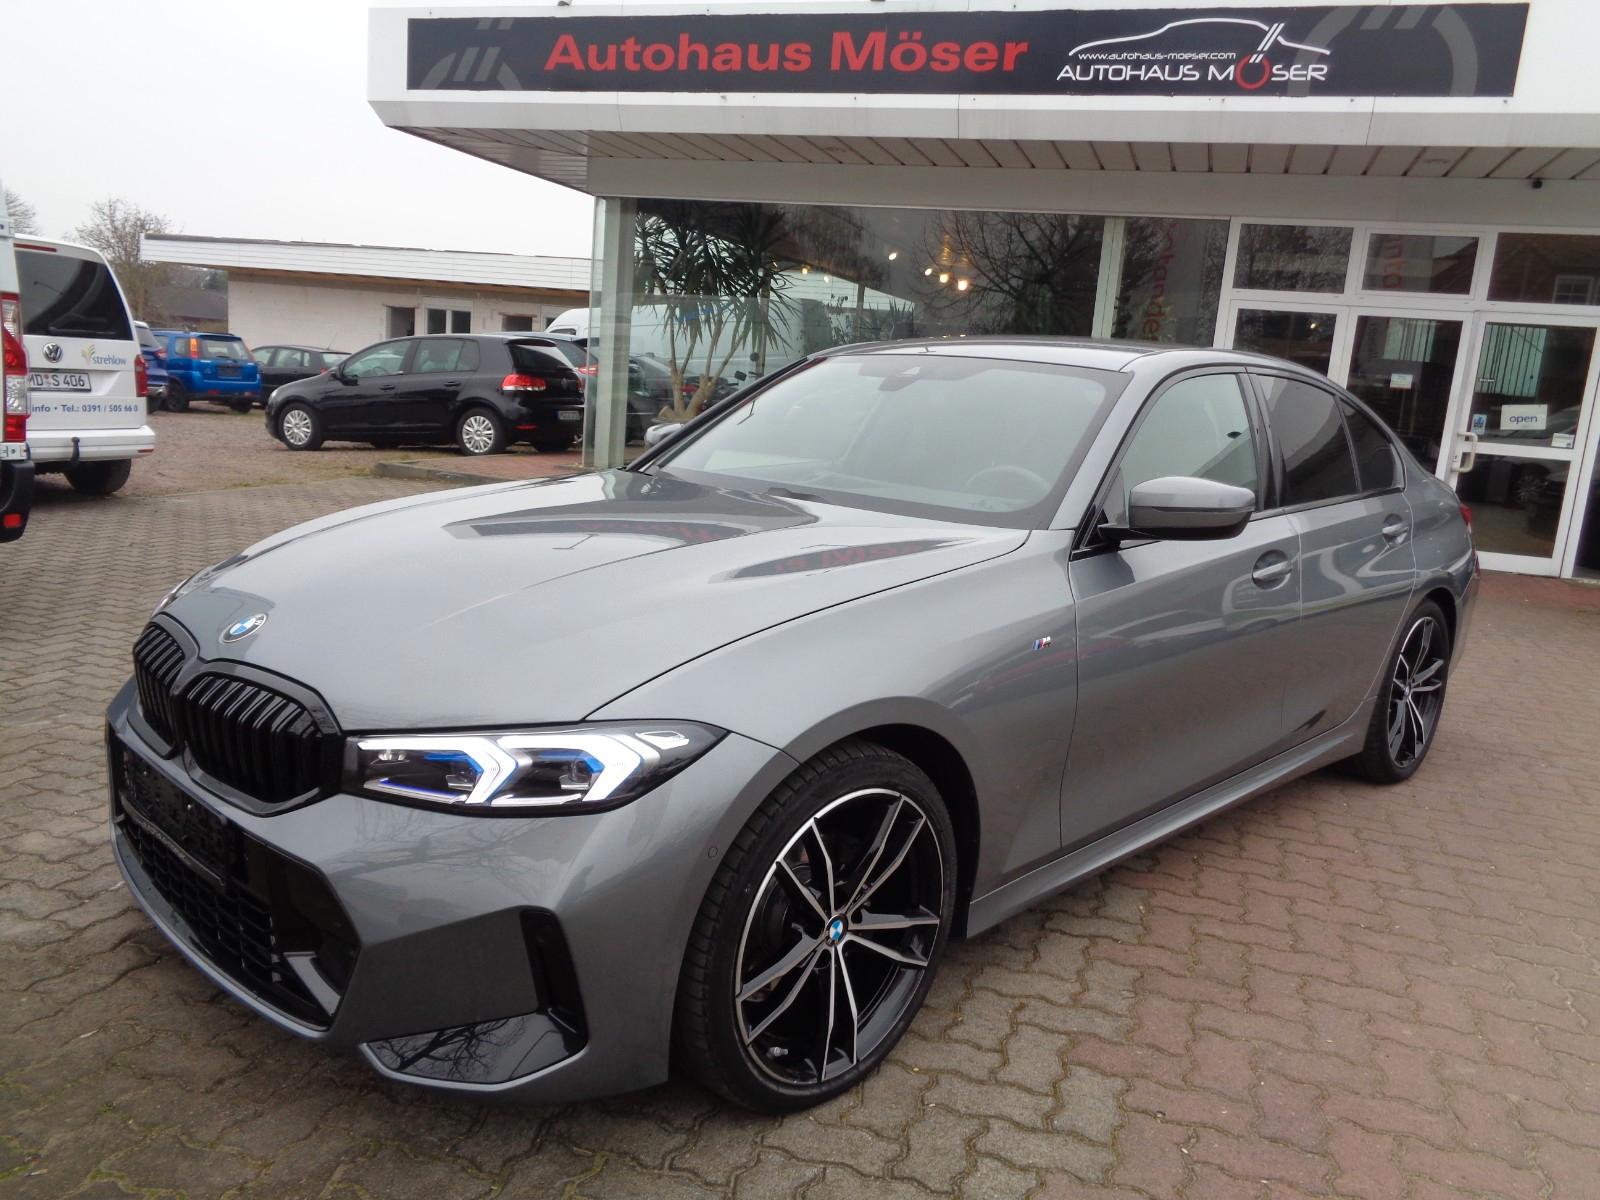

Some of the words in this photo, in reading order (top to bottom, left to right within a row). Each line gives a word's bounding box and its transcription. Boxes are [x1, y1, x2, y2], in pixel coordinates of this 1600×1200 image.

[545, 33, 811, 72] Autohaus
[830, 30, 1028, 72] Möser
[1078, 51, 1236, 61] www.autohaus-moeser.com
[1056, 64, 1200, 81] AUTOHAUS
[92, 354, 127, 366] strehlow
[52, 374, 60, 387] S
[63, 375, 85, 387] 406
[81, 404, 101, 413] 0391
[109, 404, 122, 413] 505
[1509, 414, 1538, 425] open
